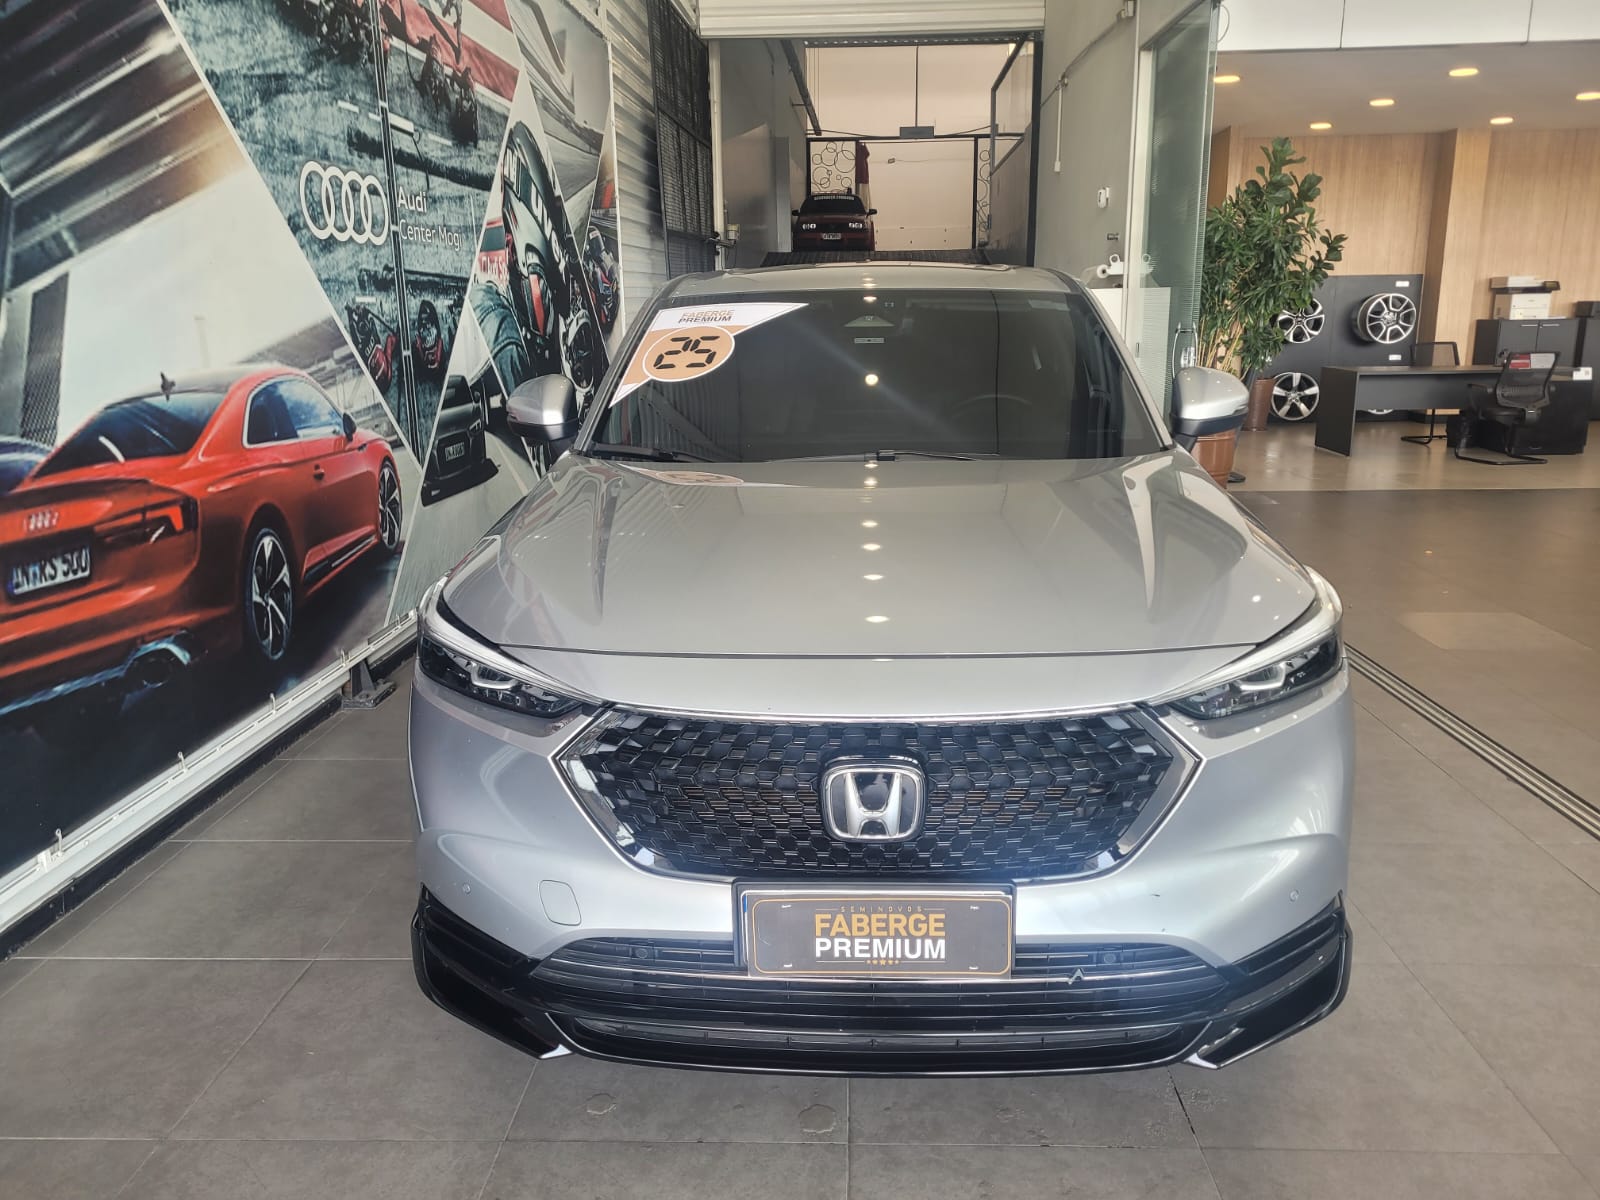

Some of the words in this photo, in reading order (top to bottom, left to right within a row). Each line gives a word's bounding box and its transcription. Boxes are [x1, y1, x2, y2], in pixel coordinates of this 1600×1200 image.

[397, 186, 427, 213] Audi
[398, 219, 436, 243] Center
[437, 226, 463, 251] Mogi
[678, 315, 732, 324] PREMIUM
[681, 309, 735, 319] FABERGE
[653, 335, 720, 370] 25
[840, 905, 923, 913] SEMINOVOS
[815, 913, 946, 937] FABERGE
[815, 938, 946, 959] PREMIUM
